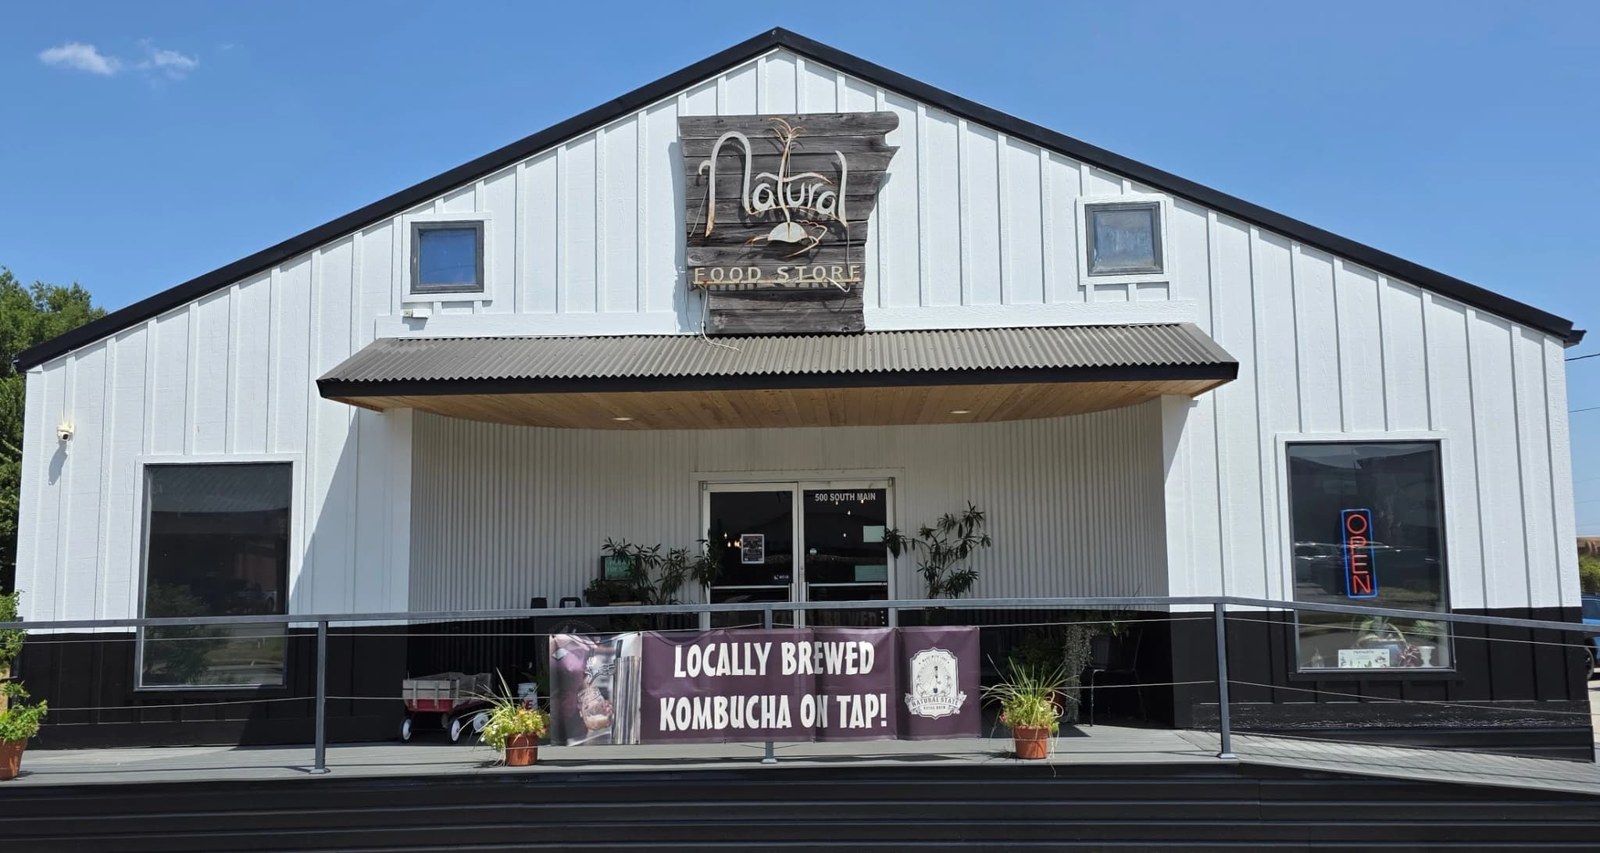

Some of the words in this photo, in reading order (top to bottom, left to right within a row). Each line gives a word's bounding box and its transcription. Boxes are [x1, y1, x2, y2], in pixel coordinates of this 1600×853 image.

[698, 129, 848, 237] Natural
[693, 266, 762, 284] FOOD
[776, 265, 862, 284] STORE
[814, 493, 829, 502] 500
[829, 492, 855, 502] SOUTH
[856, 492, 876, 501] MAIN
[1346, 514, 1371, 594] OPEN
[673, 642, 772, 678] LOCALLY
[781, 641, 875, 676] BREWED
[659, 694, 792, 731] KOMBUCHA
[800, 693, 829, 728] ON
[836, 693, 887, 729] TAP!
[911, 697, 939, 708] NATURAL
[941, 697, 959, 706] STATE
